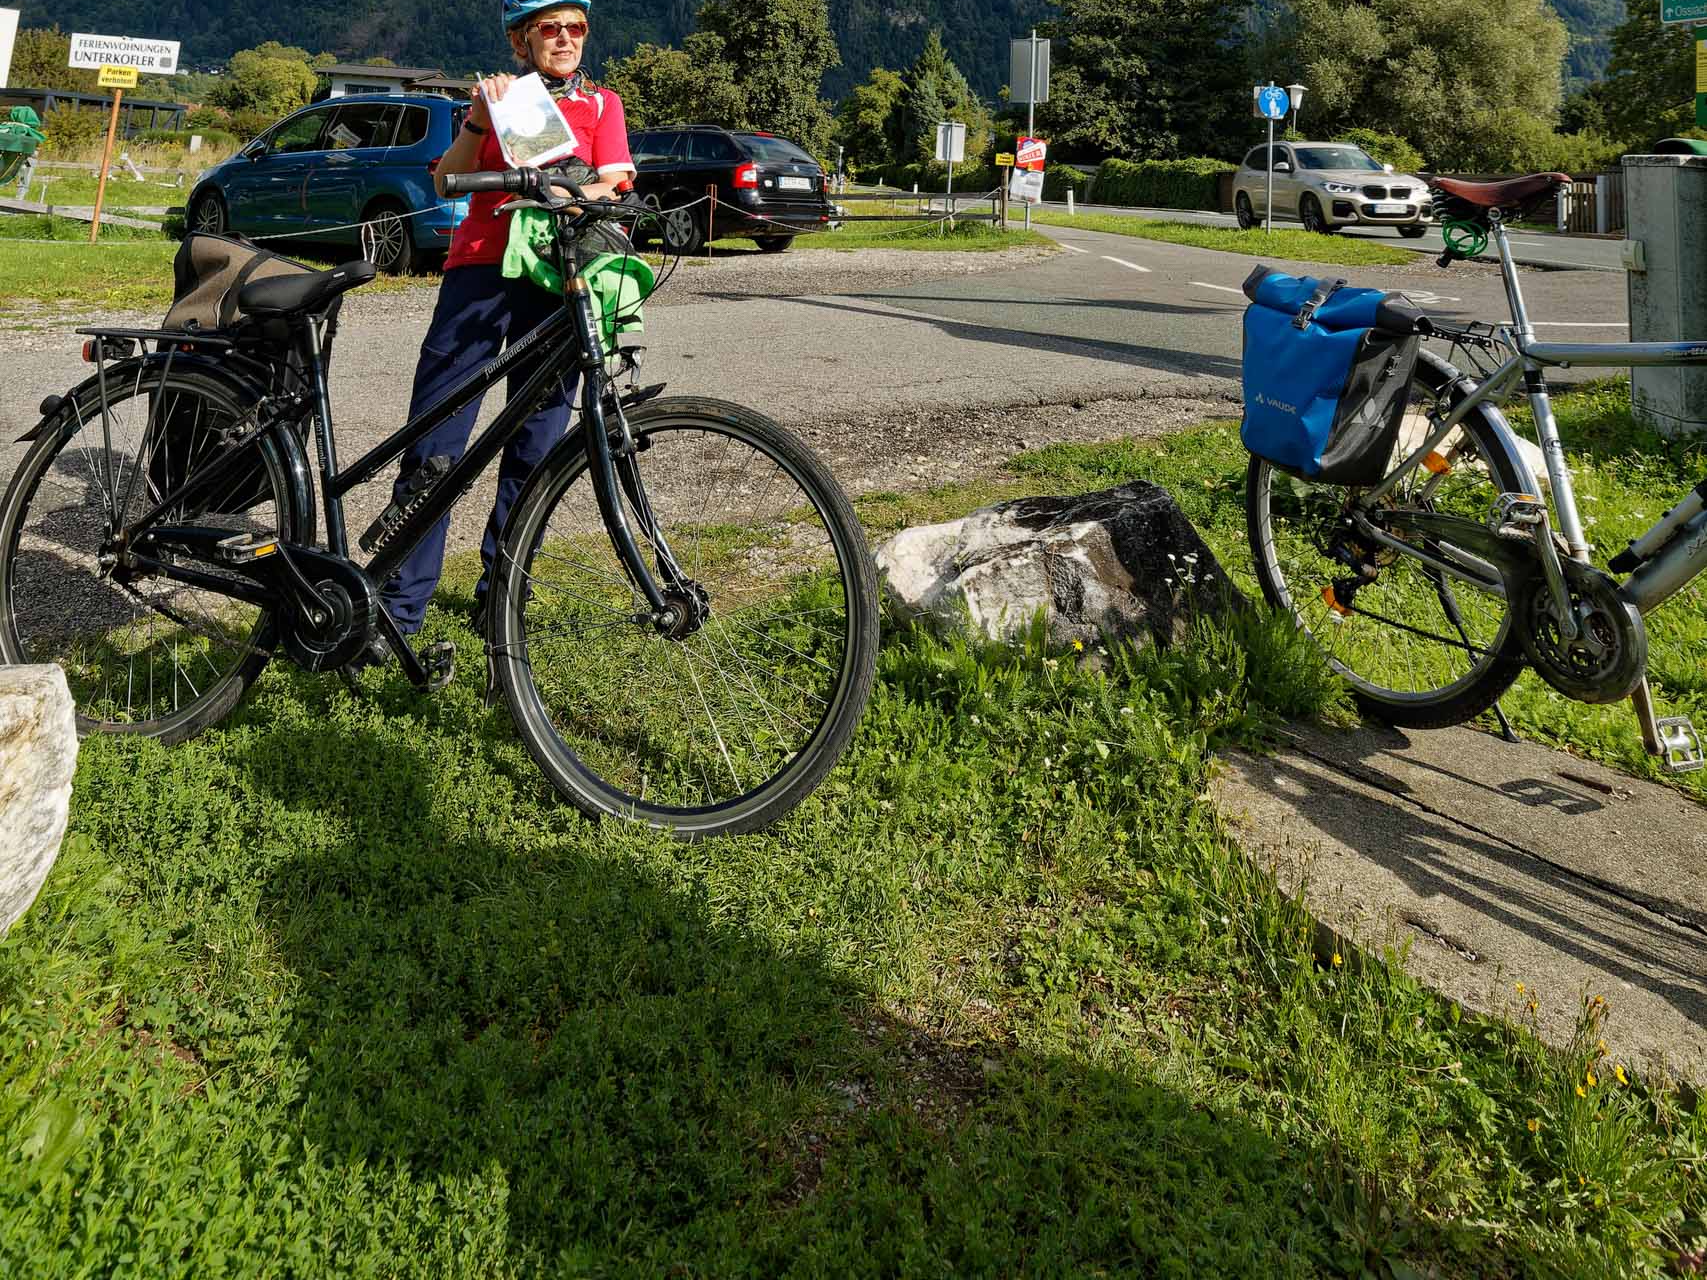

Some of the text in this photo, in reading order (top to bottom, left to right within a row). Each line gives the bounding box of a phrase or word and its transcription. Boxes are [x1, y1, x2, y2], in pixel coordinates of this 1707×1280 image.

[79, 39, 171, 54] FERIENWOHNUNGEN
[74, 51, 154, 67] UNTERKOFLER
[106, 67, 132, 77] Parken
[1266, 396, 1297, 415] VAUDE
